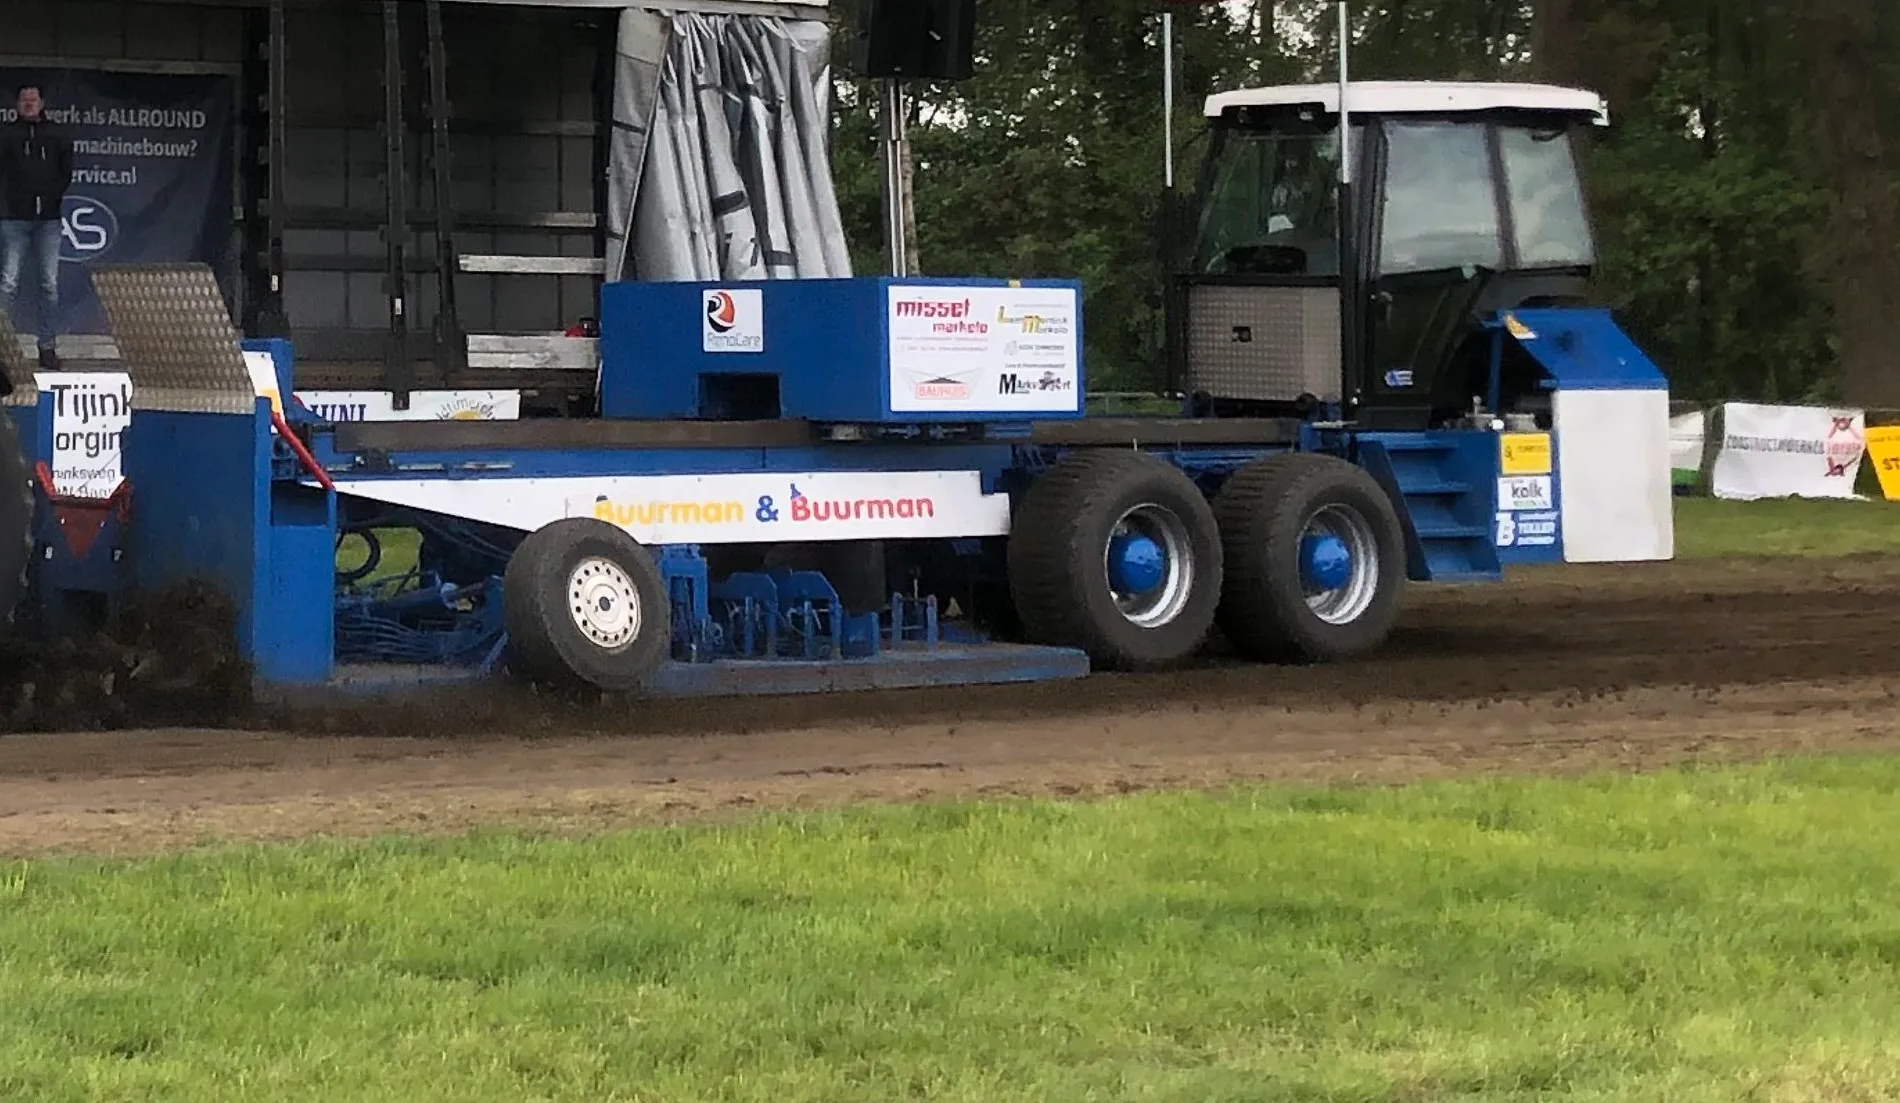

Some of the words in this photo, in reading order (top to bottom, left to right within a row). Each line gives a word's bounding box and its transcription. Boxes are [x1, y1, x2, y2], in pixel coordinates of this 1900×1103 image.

[83, 106, 106, 125] als
[108, 109, 206, 128] ALLROUND
[73, 138, 197, 157] machinebouw?
[756, 495, 779, 523] &
[791, 495, 934, 522] Buurman
